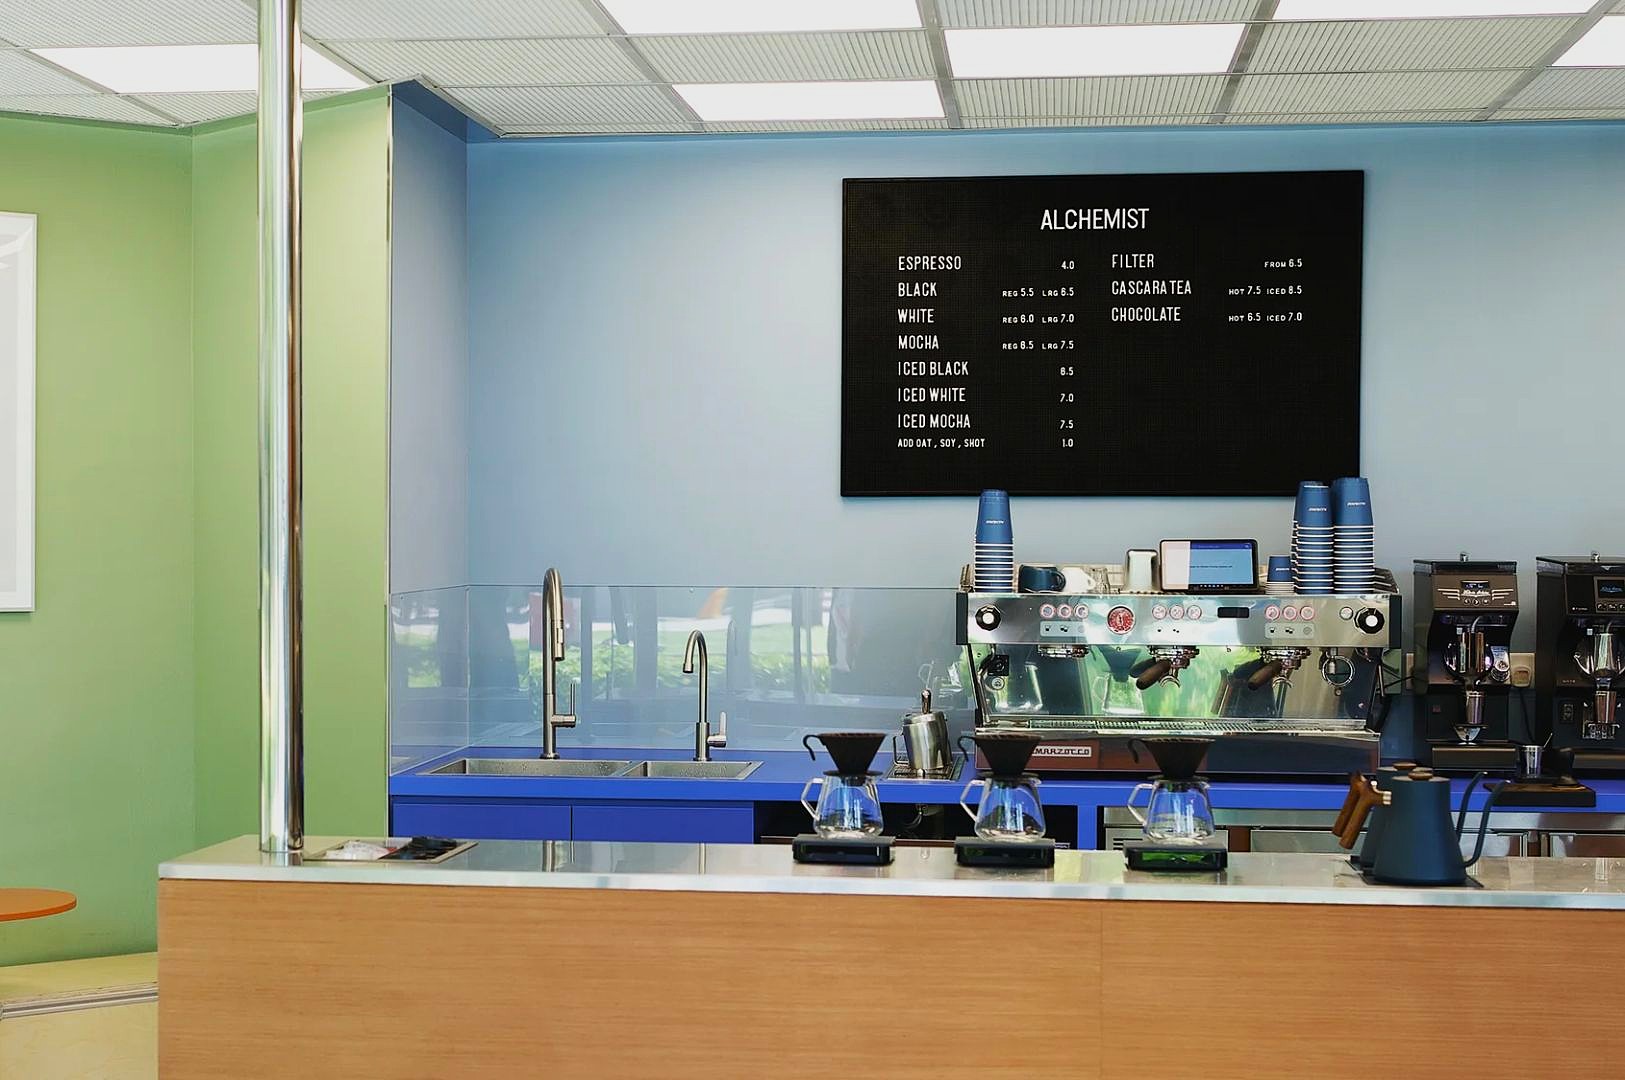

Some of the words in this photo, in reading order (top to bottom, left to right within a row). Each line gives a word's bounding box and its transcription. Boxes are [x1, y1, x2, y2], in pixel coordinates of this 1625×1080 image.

[1040, 208, 1150, 230] ALCHEMIST
[898, 255, 962, 270] ESPRESSO
[1061, 260, 1075, 270] 4.0
[1111, 254, 1155, 269] FILTER
[1288, 258, 1303, 268] 6.5
[898, 282, 938, 297] BLACK
[1002, 290, 1019, 298] REG
[1020, 287, 1035, 297] 5.5
[1042, 289, 1059, 297] LRG
[1060, 286, 1075, 297] 6.5
[1111, 280, 1167, 295] CASCARA
[1169, 279, 1192, 295] TEA
[1228, 288, 1245, 296] HOT
[1247, 285, 1262, 295] 7.5
[1266, 288, 1287, 296] ICED
[897, 308, 935, 323] WHITE
[1002, 316, 1019, 324] REG
[1020, 313, 1035, 324] 6.0
[1041, 316, 1059, 324] LRG
[1060, 313, 1075, 324] 7.0
[1111, 306, 1181, 322] CHOCOLATE
[1228, 315, 1245, 323] HOT
[1247, 312, 1261, 322] 6.5
[1288, 311, 1303, 322] 7.0
[898, 335, 940, 350] MOCHA
[1002, 342, 1018, 350] REG
[1041, 342, 1059, 350] LRG
[1060, 340, 1074, 350] 7.5
[898, 361, 926, 376] ICED
[929, 361, 969, 376] BLACK
[898, 388, 926, 402] ICED
[929, 387, 966, 402] WHITE
[1060, 393, 1074, 403] 7.0
[898, 414, 926, 429] ICED
[929, 414, 971, 429] MOCHA
[1060, 419, 1074, 429] 7.5
[897, 438, 914, 448] ADD
[963, 438, 986, 448] SHOT
[1062, 438, 1074, 448] 1.0
